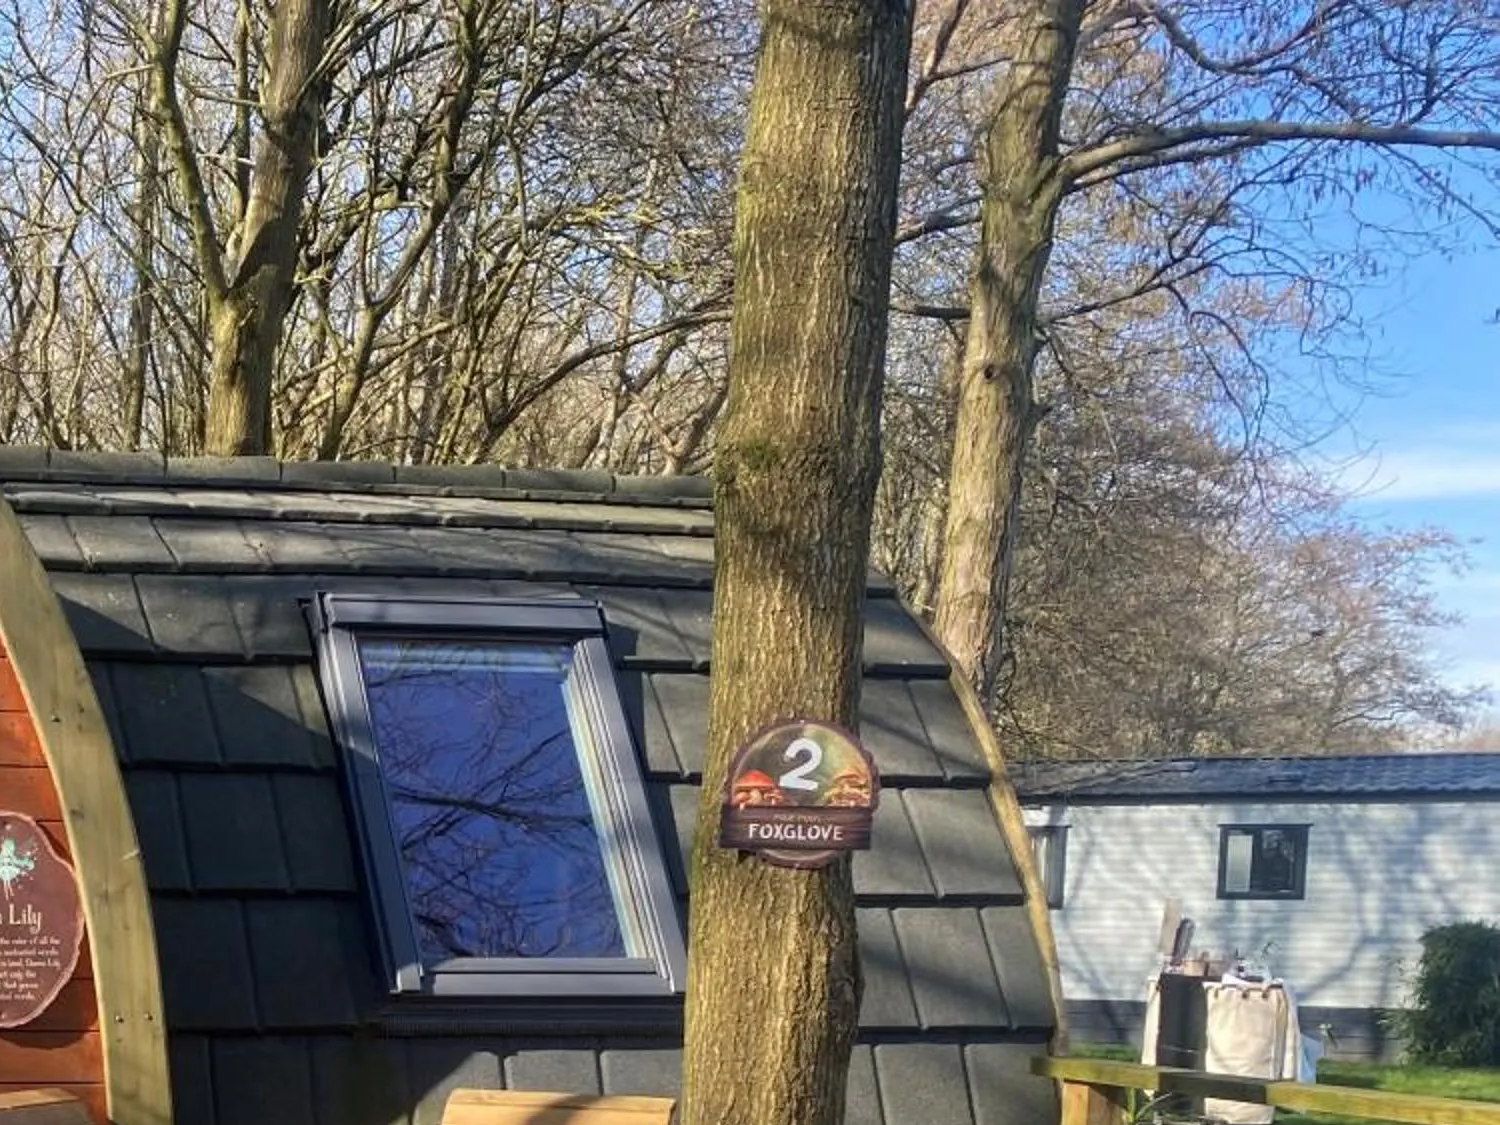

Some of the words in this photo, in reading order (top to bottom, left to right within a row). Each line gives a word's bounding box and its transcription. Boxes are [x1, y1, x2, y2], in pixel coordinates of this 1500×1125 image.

[779, 738, 822, 790] 2
[748, 823, 843, 841] FOXGLOVE
[9, 903, 41, 934] Lily
